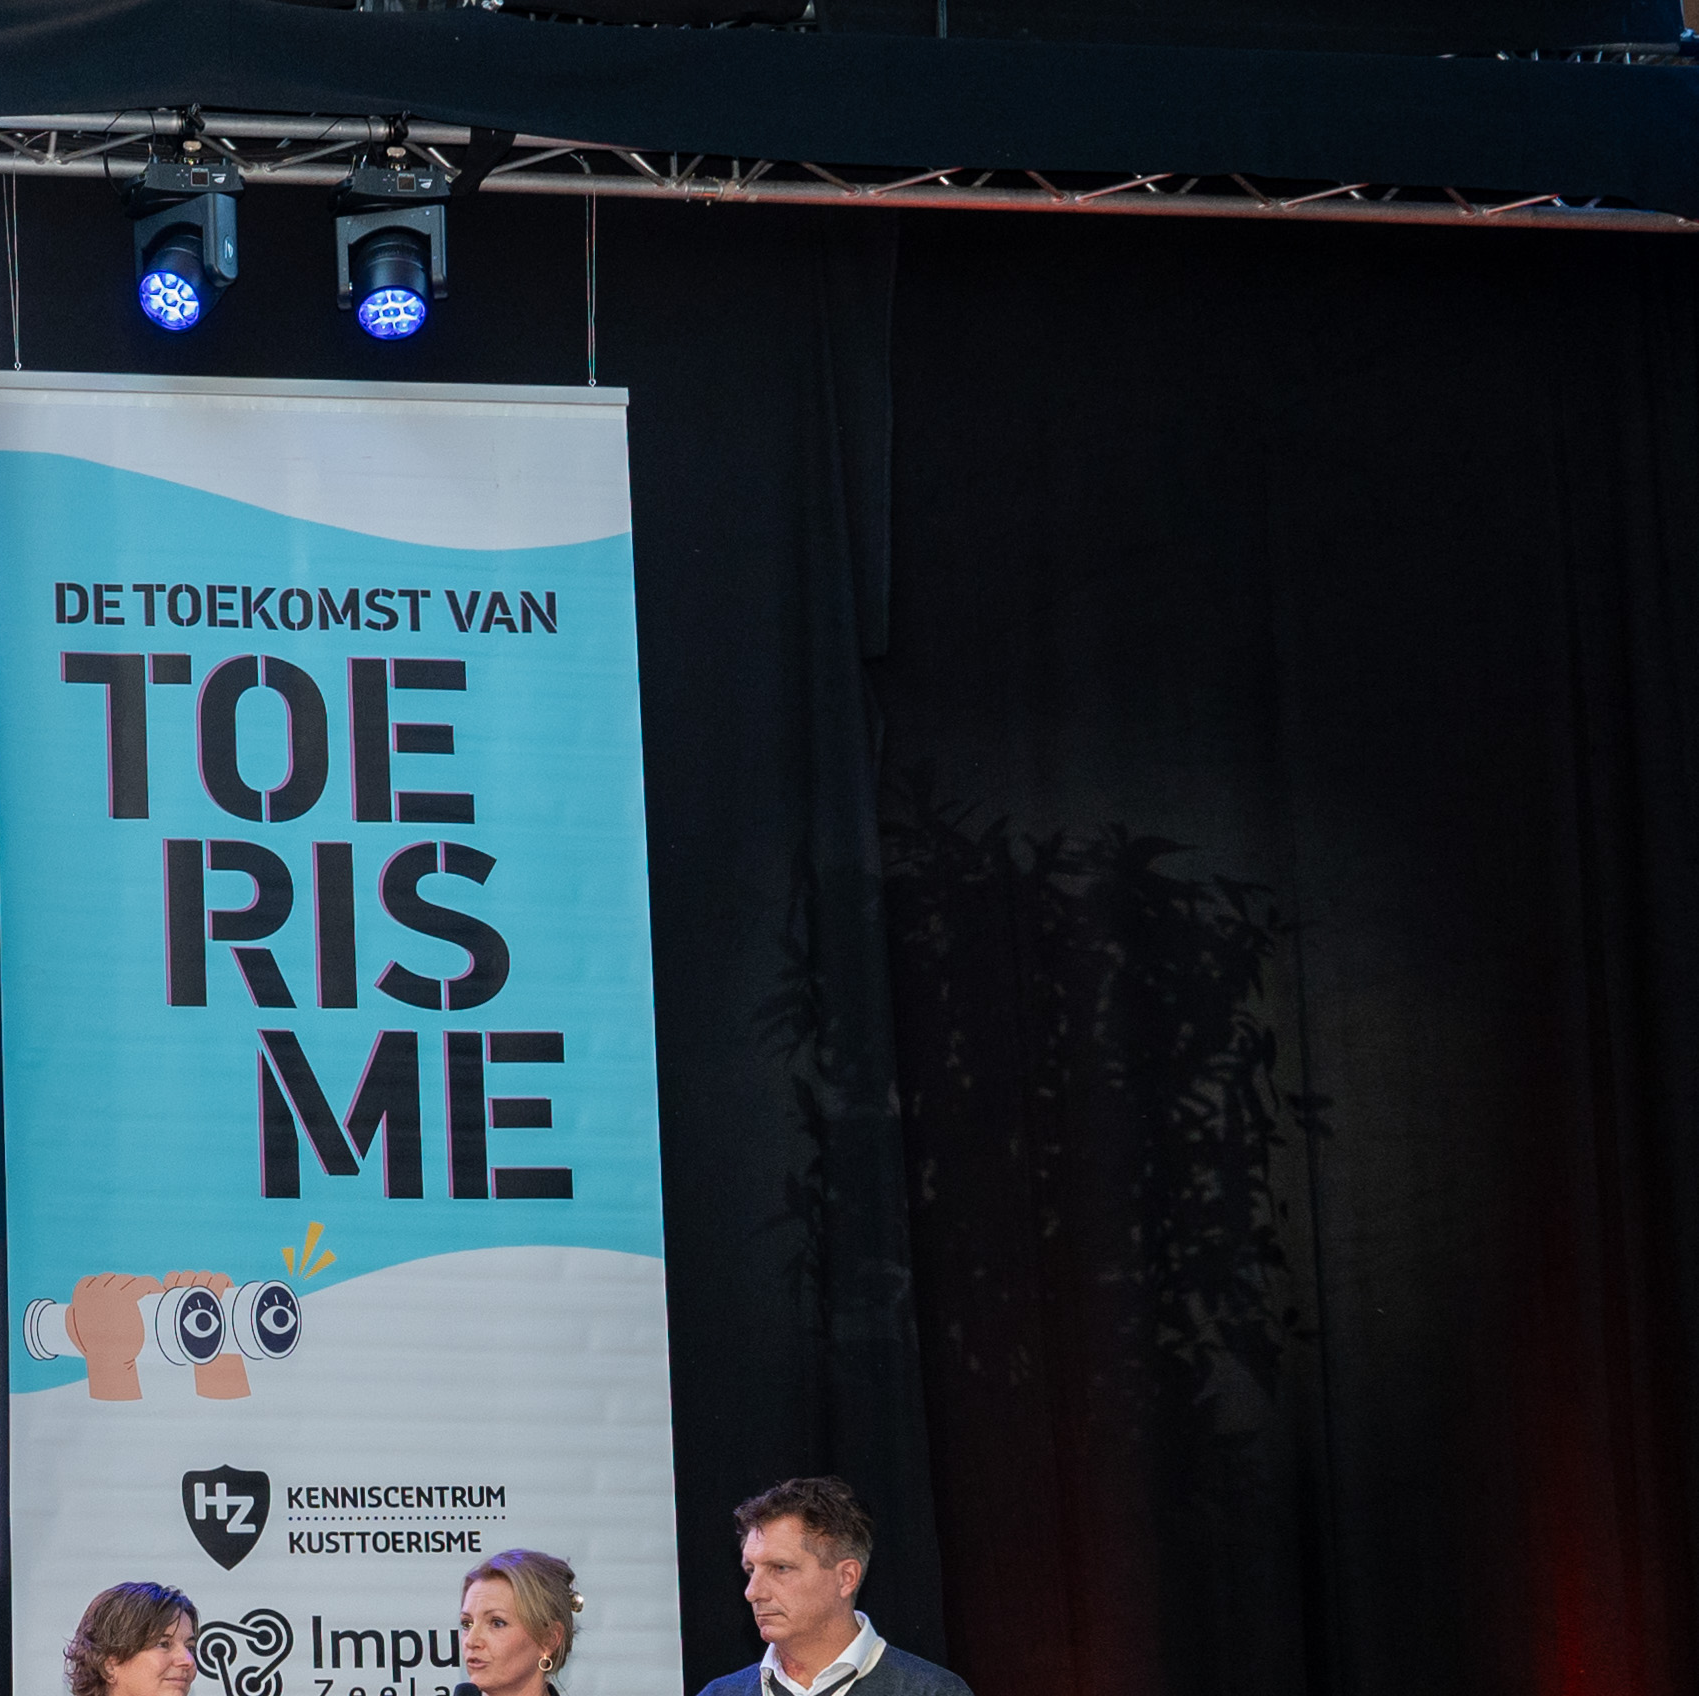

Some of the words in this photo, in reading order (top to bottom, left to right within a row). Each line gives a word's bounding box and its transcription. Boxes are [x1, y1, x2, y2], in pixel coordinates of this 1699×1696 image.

[55, 582, 125, 626] DE
[133, 583, 431, 632] TOEKOMST
[446, 589, 558, 633] VAN
[60, 651, 475, 824] TOE
[163, 838, 510, 1012] RIS
[257, 1028, 574, 1199] ME
[287, 1486, 506, 1509] KENNISCENTRUM
[288, 1531, 482, 1554] KUSTTOERISME
[312, 1616, 461, 1684] Impu
